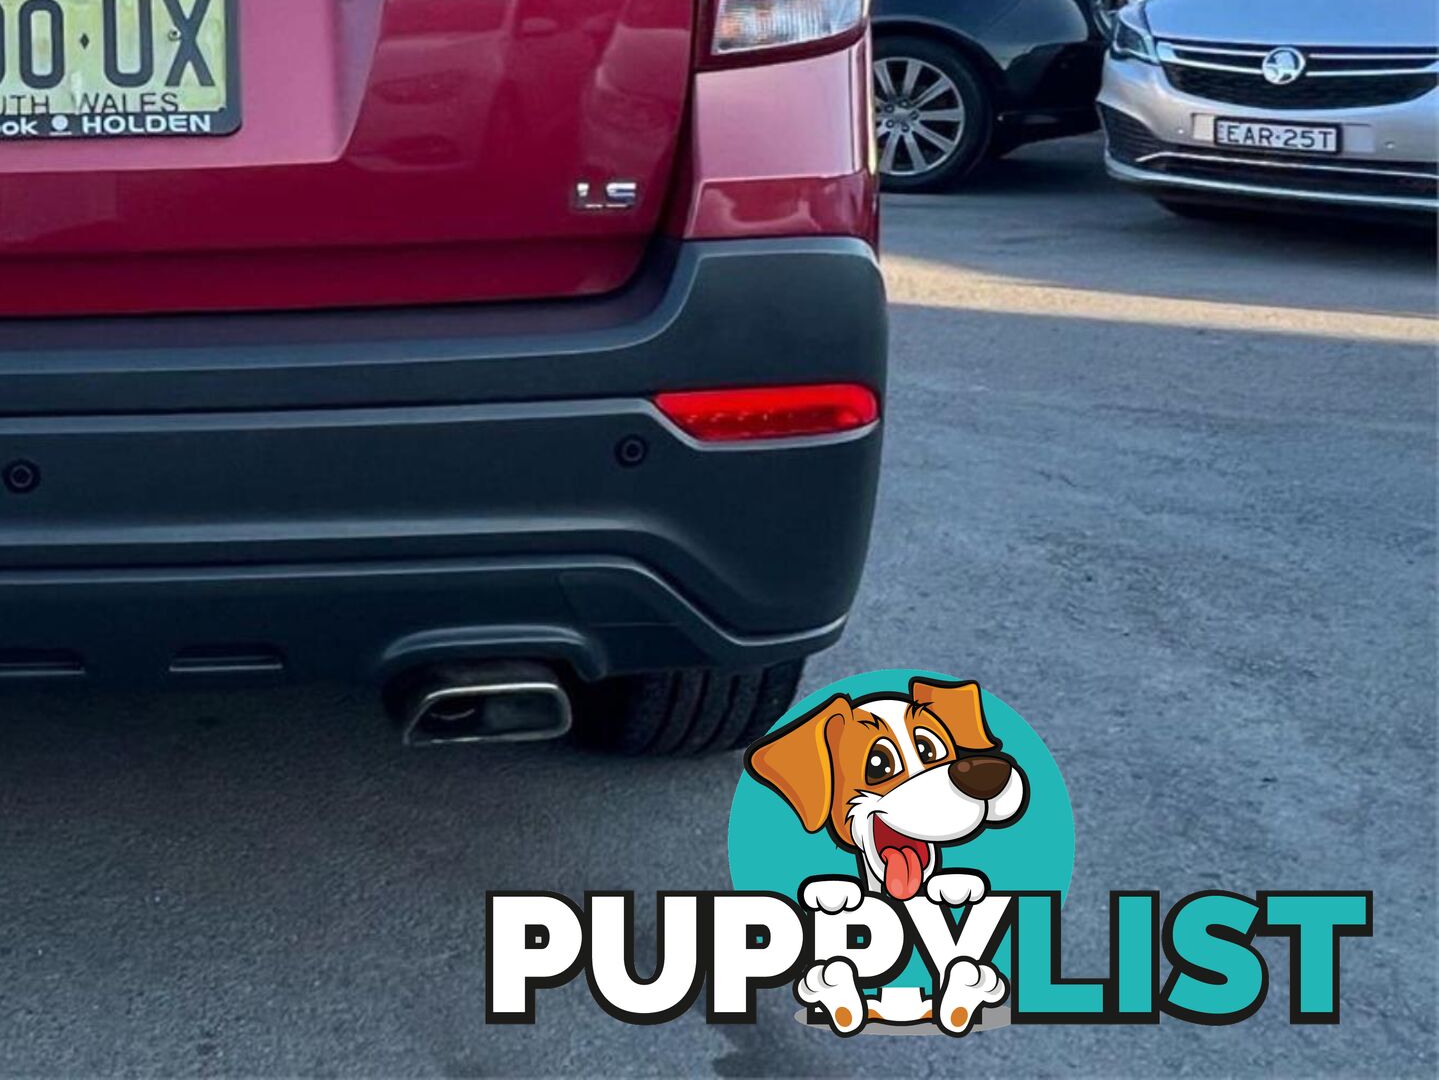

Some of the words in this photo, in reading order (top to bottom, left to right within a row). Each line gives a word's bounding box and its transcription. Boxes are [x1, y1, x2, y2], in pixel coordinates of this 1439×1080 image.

[79, 92, 179, 114] WALES
[81, 113, 212, 134] HOLDEN
[576, 182, 637, 209] LS
